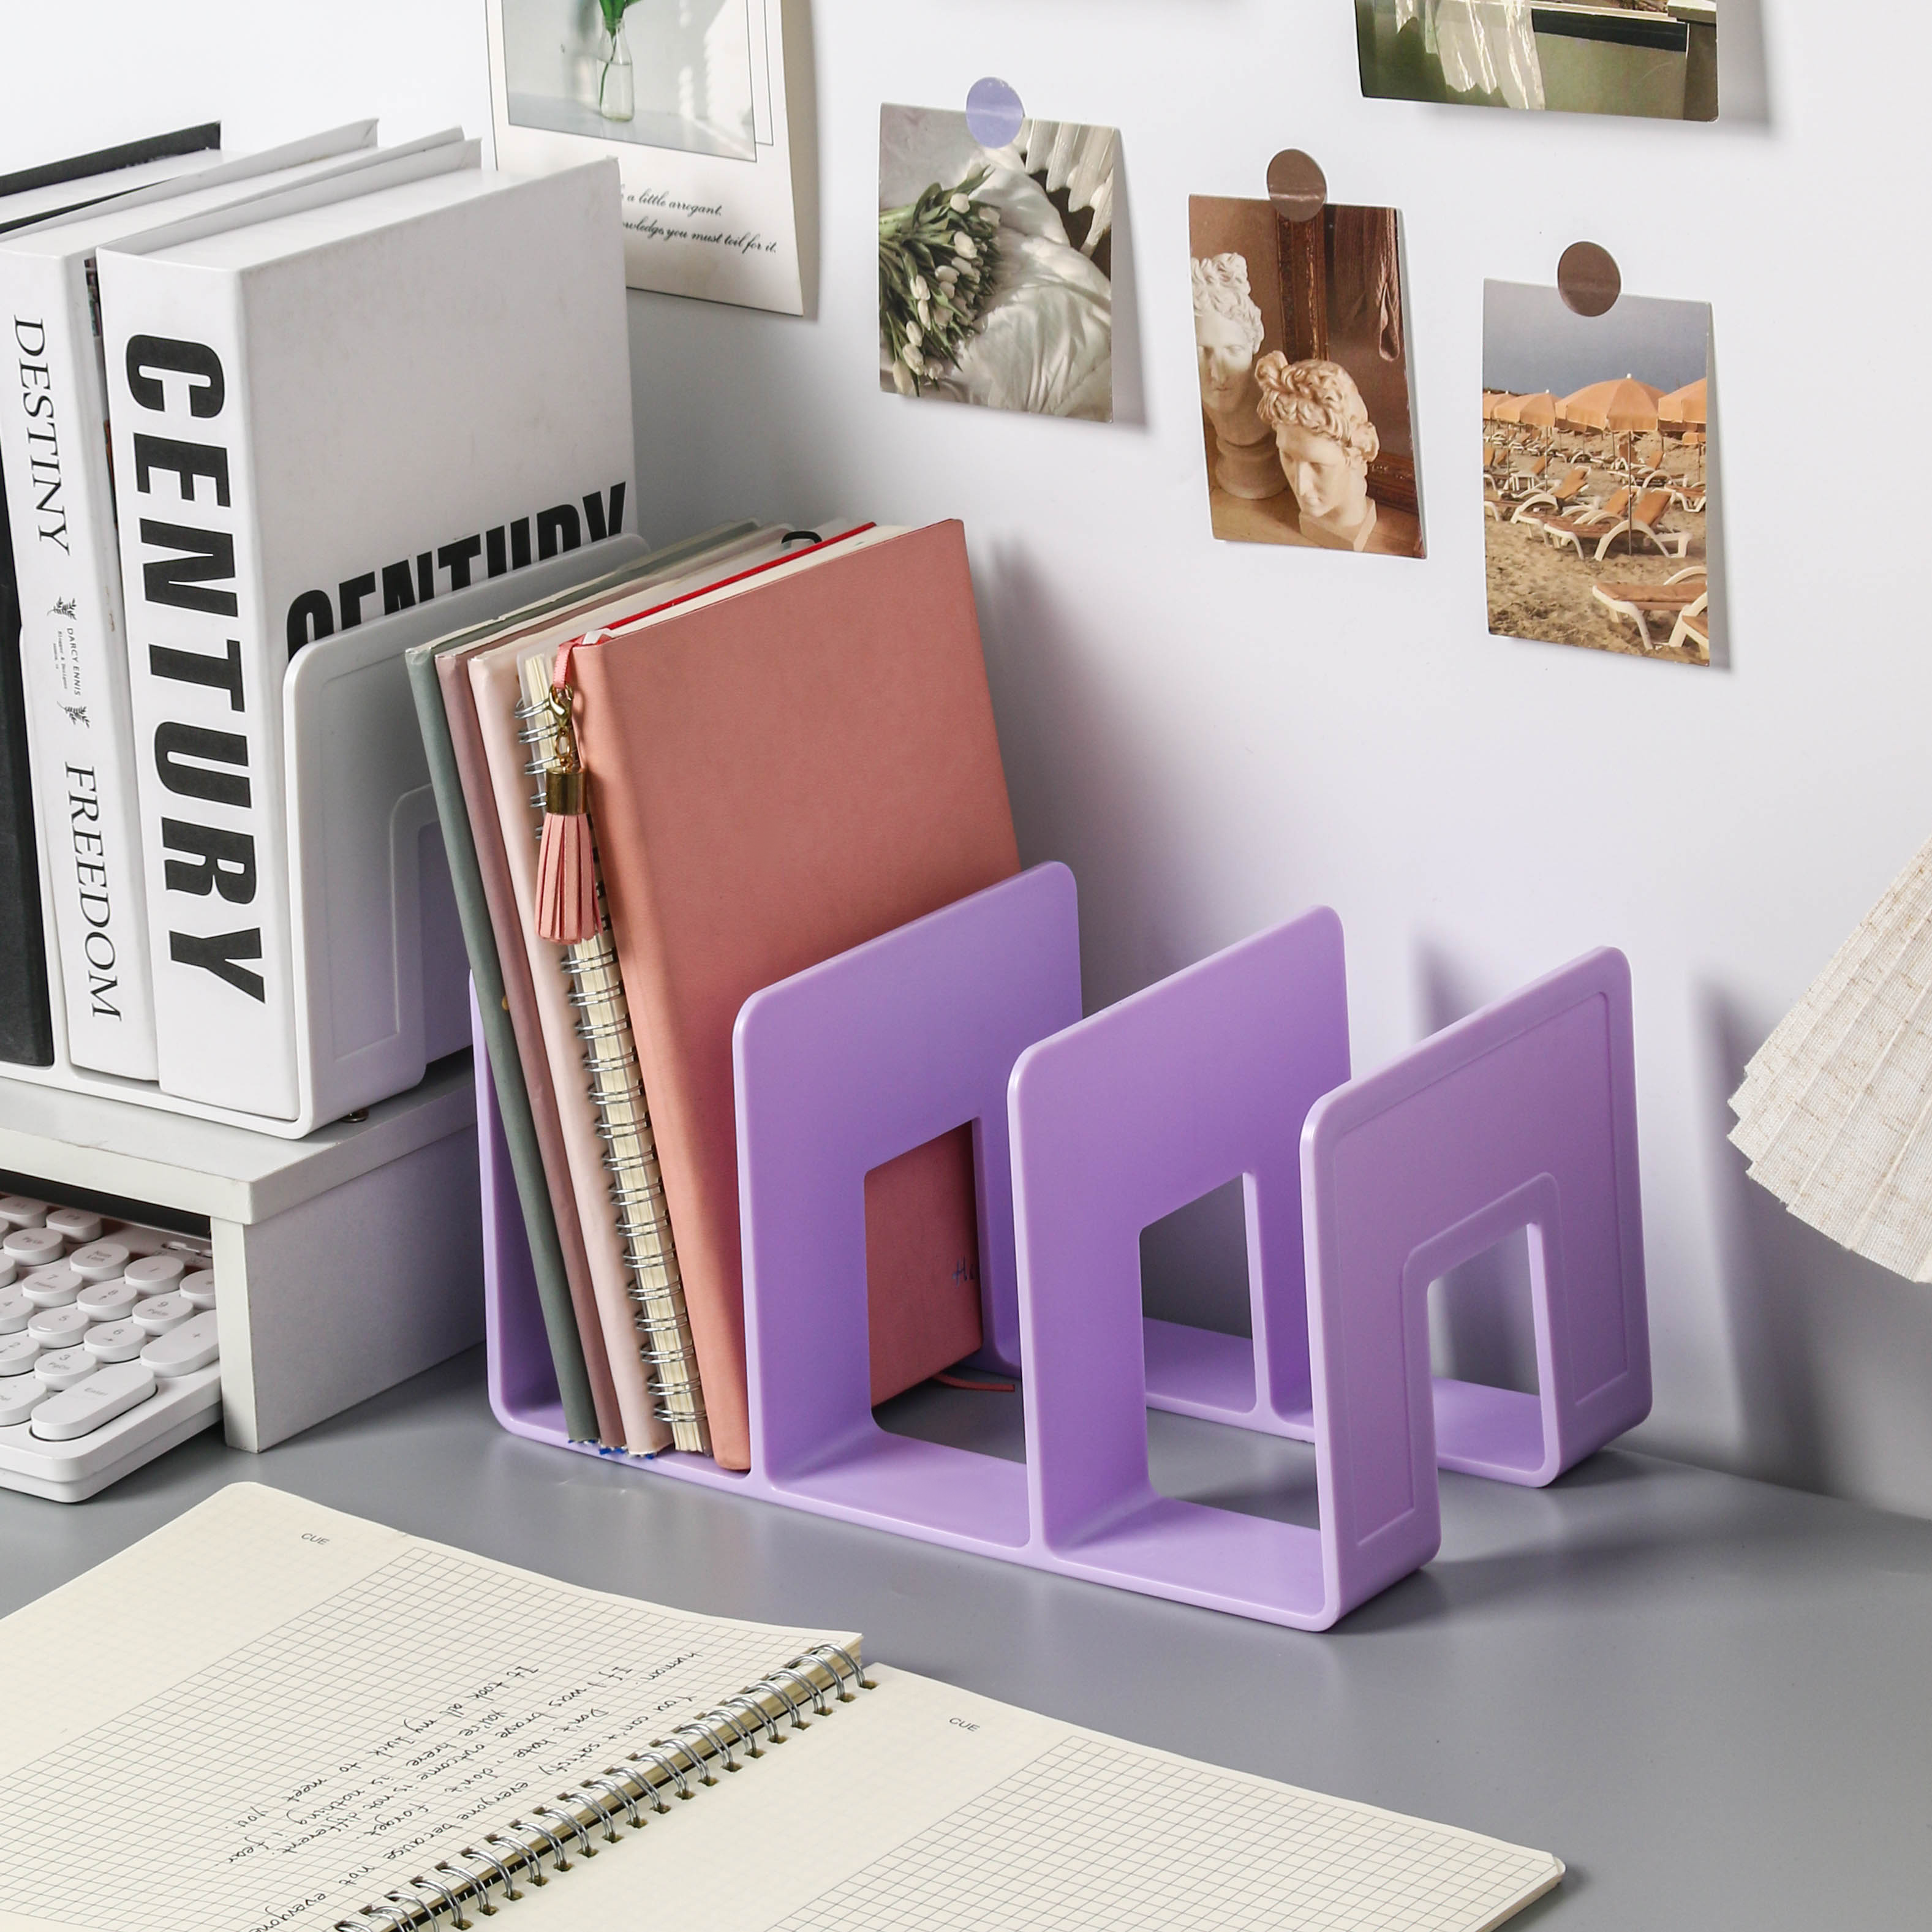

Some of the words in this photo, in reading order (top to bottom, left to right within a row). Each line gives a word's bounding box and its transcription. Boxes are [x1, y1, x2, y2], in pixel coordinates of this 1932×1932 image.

[639, 188, 670, 206] little
[668, 200, 723, 217] arrogant.
[663, 228, 688, 241] you
[691, 232, 724, 243] must
[724, 232, 747, 247] toil
[742, 234, 762, 254] for
[765, 240, 777, 254] it.
[13, 314, 72, 556] DESTINY
[67, 628, 79, 663] DARCY
[126, 333, 265, 1004] CENTURY
[72, 666, 81, 696] ENNIS
[64, 761, 122, 1022] FREEDOM
[301, 1532, 330, 1545] CUE
[506, 1666, 539, 1678] It
[598, 1666, 633, 1681] If
[465, 1681, 510, 1701] took
[548, 1688, 587, 1707] was
[439, 1702, 465, 1719] all
[653, 1696, 697, 1711] You
[403, 1718, 438, 1734] my
[494, 1711, 558, 1738] brave
[553, 1708, 609, 1732] Don't
[603, 1716, 649, 1740] can't
[949, 1716, 981, 1732] CUE
[339, 1762, 362, 1773] to
[417, 1744, 485, 1781] outcome
[281, 1778, 328, 1802] meet
[371, 1776, 394, 1785] is
[393, 1784, 419, 1792] is
[444, 1767, 499, 1793] don't
[286, 1790, 366, 1825] nothing
[362, 1795, 395, 1809] not
[457, 1781, 529, 1820] everyone
[383, 1822, 464, 1860] because
[339, 1866, 375, 1885] not
